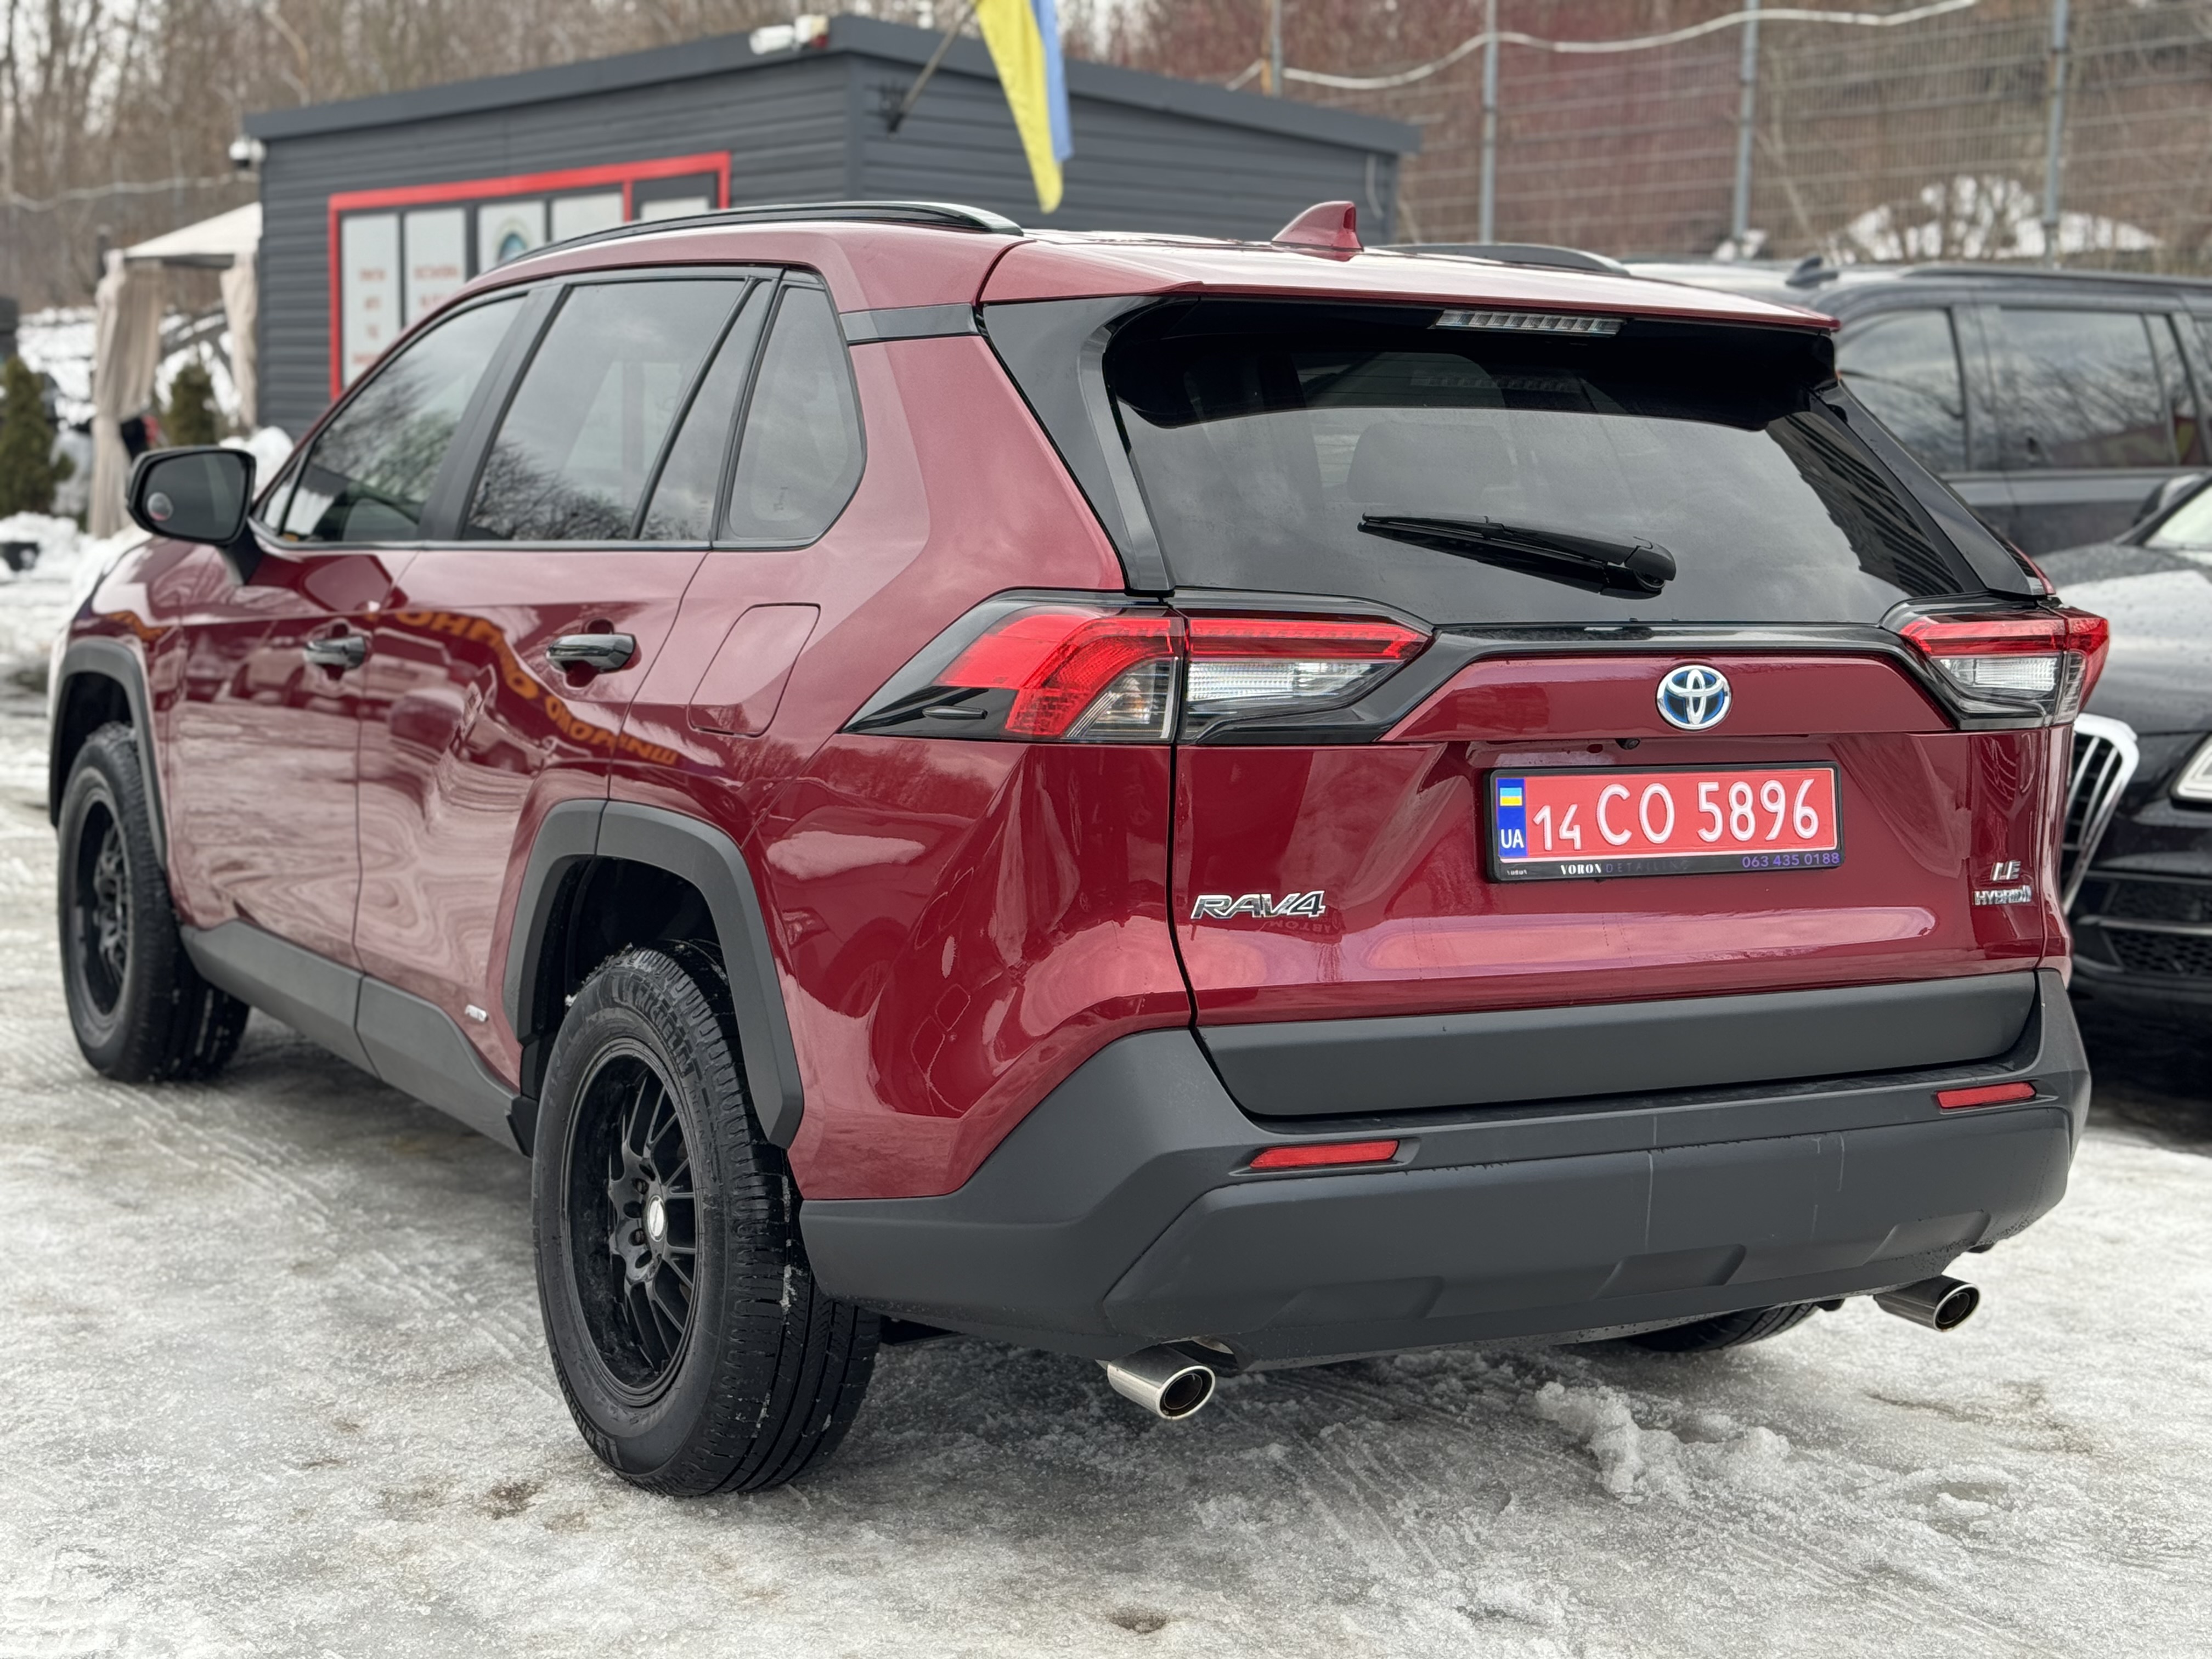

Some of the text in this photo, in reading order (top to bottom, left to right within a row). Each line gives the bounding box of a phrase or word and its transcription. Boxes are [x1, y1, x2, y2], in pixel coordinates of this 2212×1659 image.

[1533, 778, 1819, 851] 14 CO 5896
[1500, 828, 1525, 849] UA
[1560, 863, 1602, 875] VORON
[1741, 851, 1841, 868] 063 435 0188
[1991, 860, 2022, 881] LE
[1190, 890, 1326, 919] RAV4
[1973, 888, 2024, 906] HYBRID
